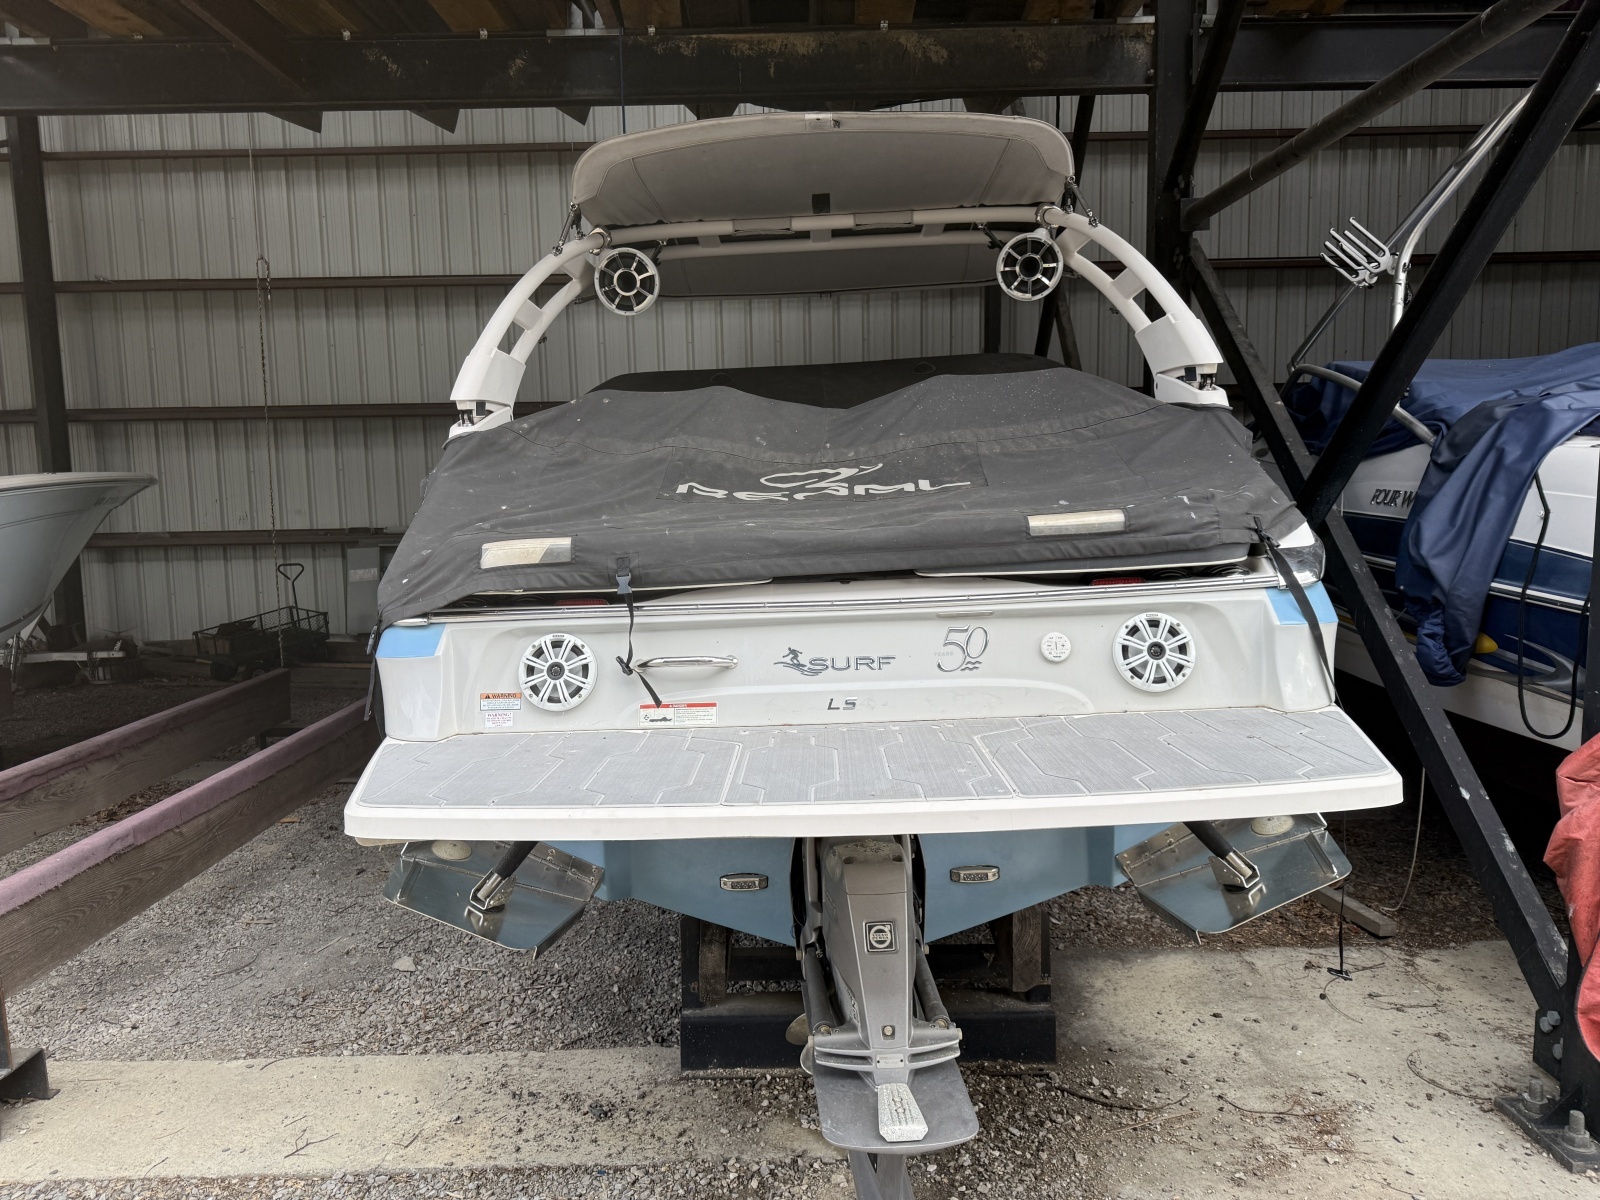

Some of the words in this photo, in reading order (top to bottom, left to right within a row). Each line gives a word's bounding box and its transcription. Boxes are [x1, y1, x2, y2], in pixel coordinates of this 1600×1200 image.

[1370, 488, 1402, 507] FOUR
[936, 624, 990, 673] 50
[807, 654, 896, 672] SURF
[827, 696, 858, 711] LS
